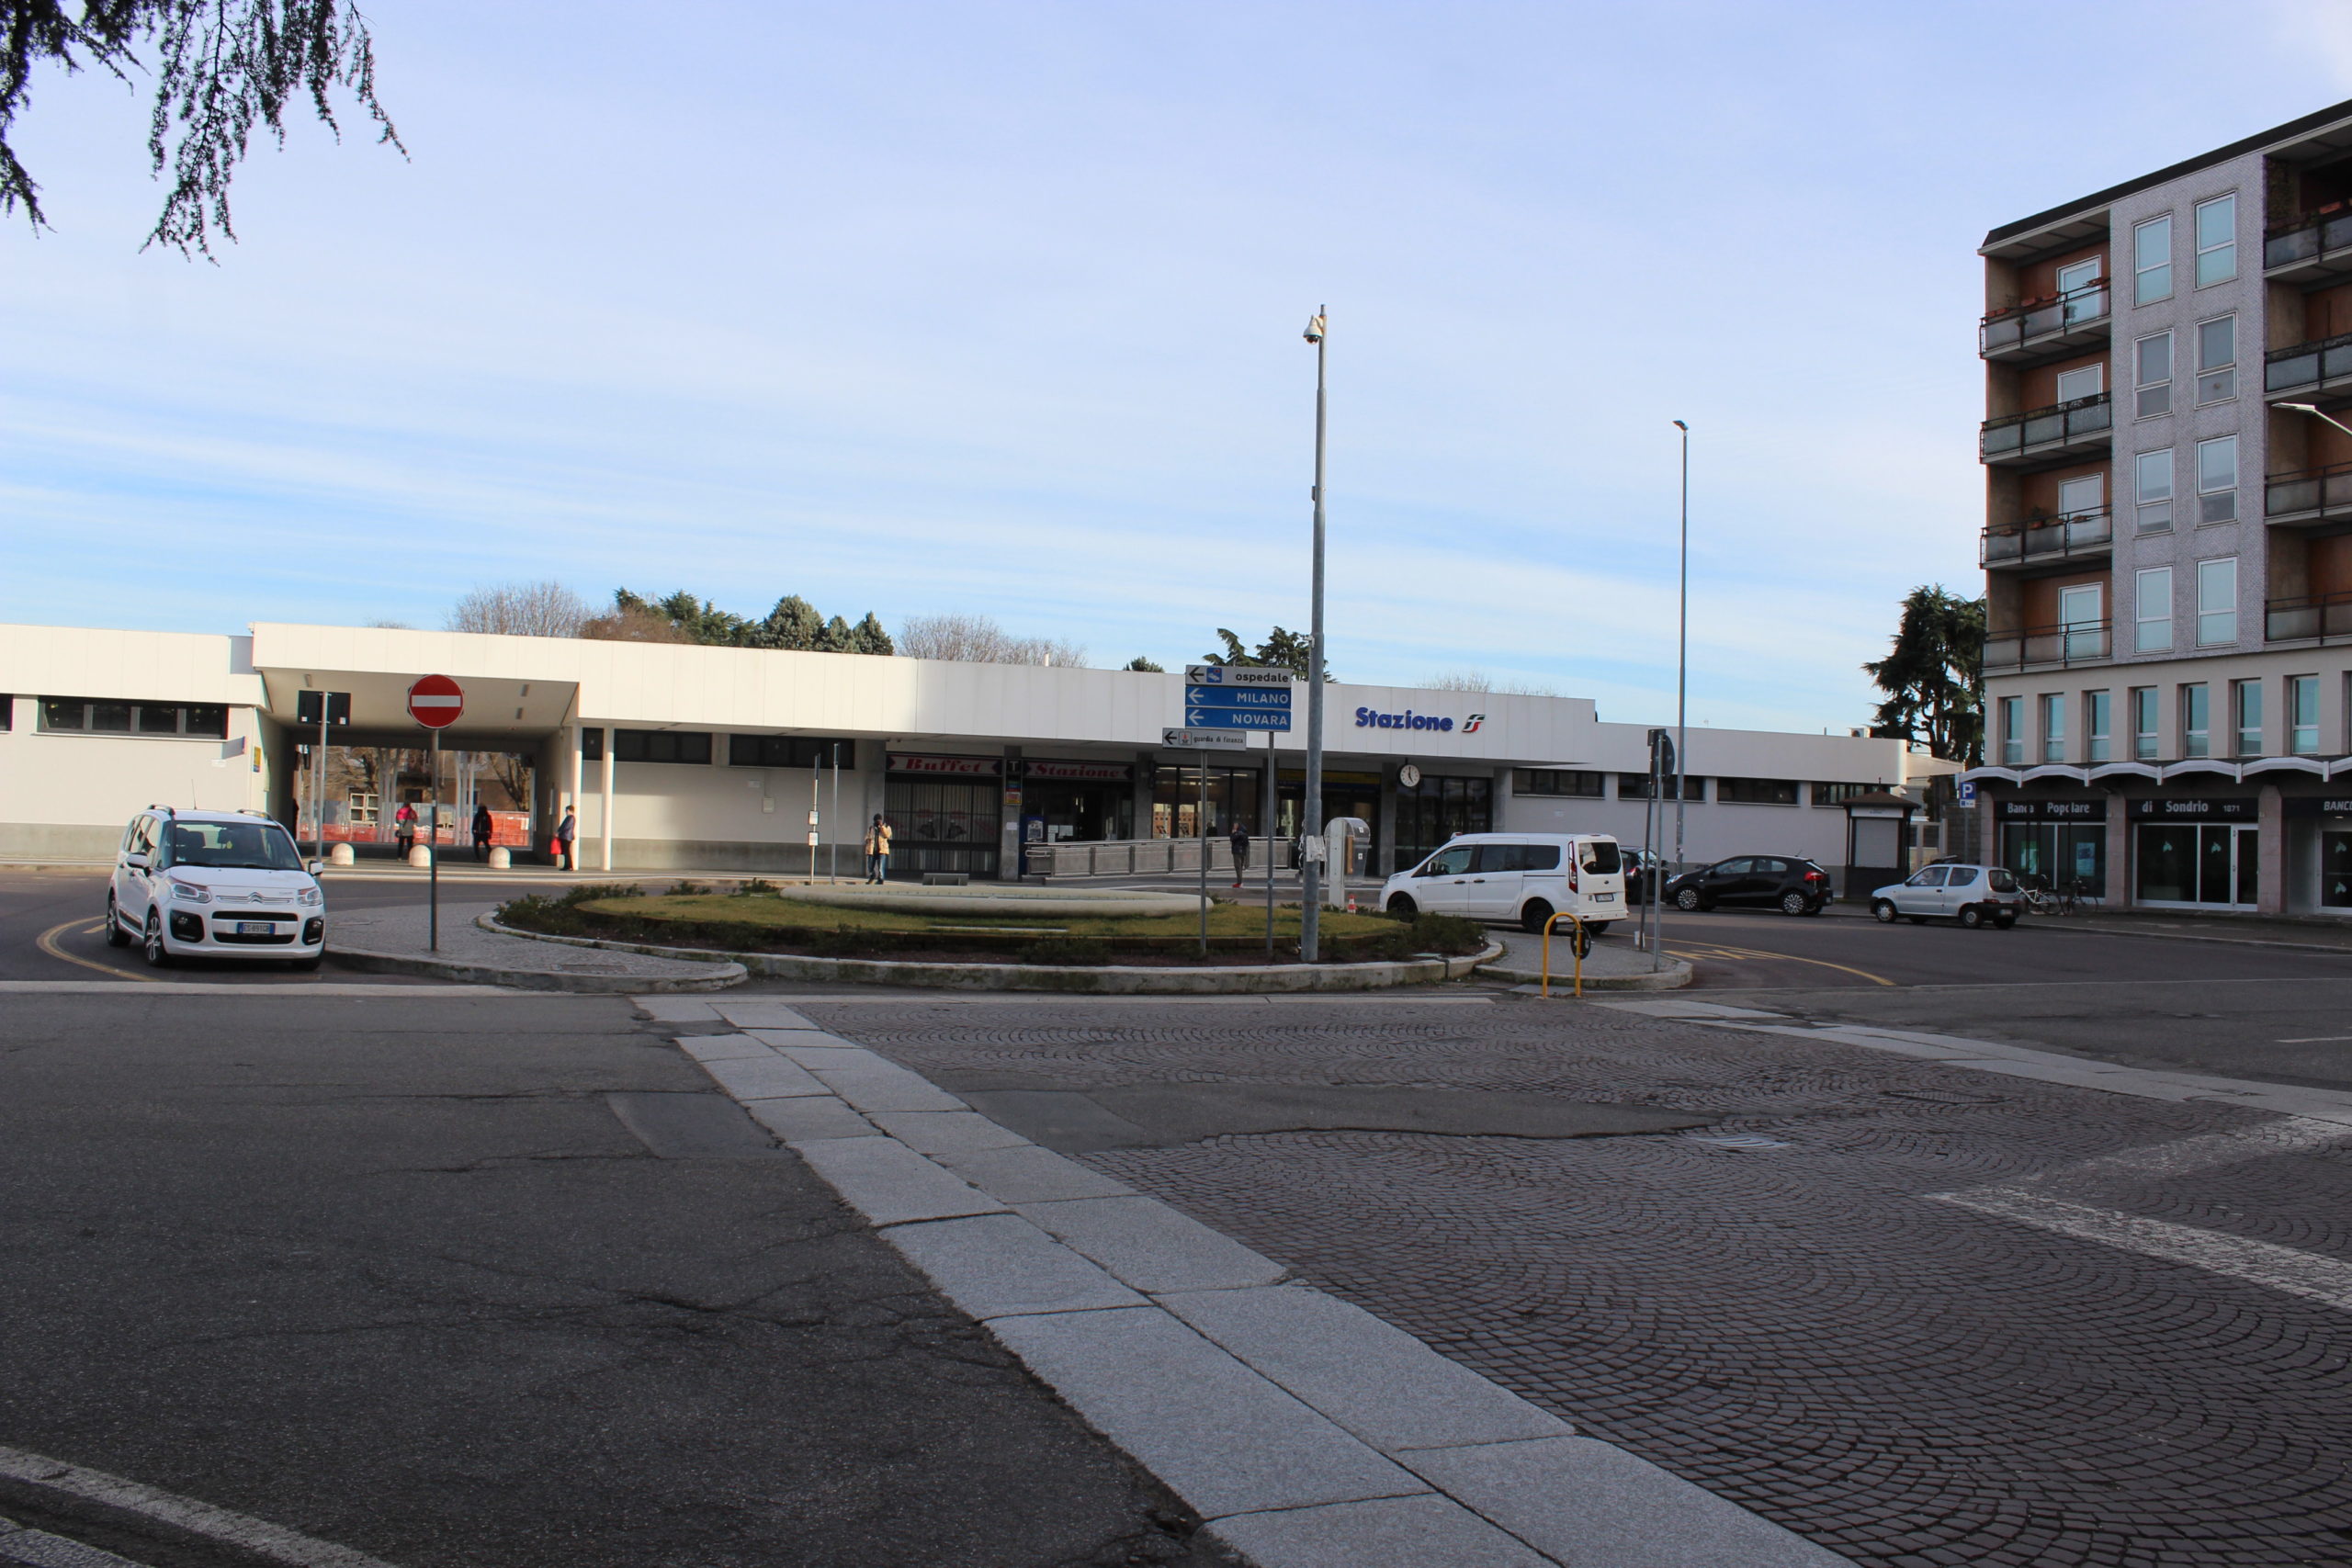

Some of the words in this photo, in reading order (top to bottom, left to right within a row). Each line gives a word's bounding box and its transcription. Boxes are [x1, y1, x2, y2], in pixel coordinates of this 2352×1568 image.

[1236, 672, 1289, 682] ospedale
[1237, 693, 1288, 704] MILANO
[1232, 714, 1288, 726] NOVARA
[1355, 706, 1453, 731] Stazione
[1193, 735, 1214, 743] guardia
[905, 758, 982, 773] Buffet
[1035, 762, 1120, 778] Stazione
[1962, 784, 1973, 798] P
[2142, 801, 2154, 813] di
[2165, 800, 2210, 813] Sondrio
